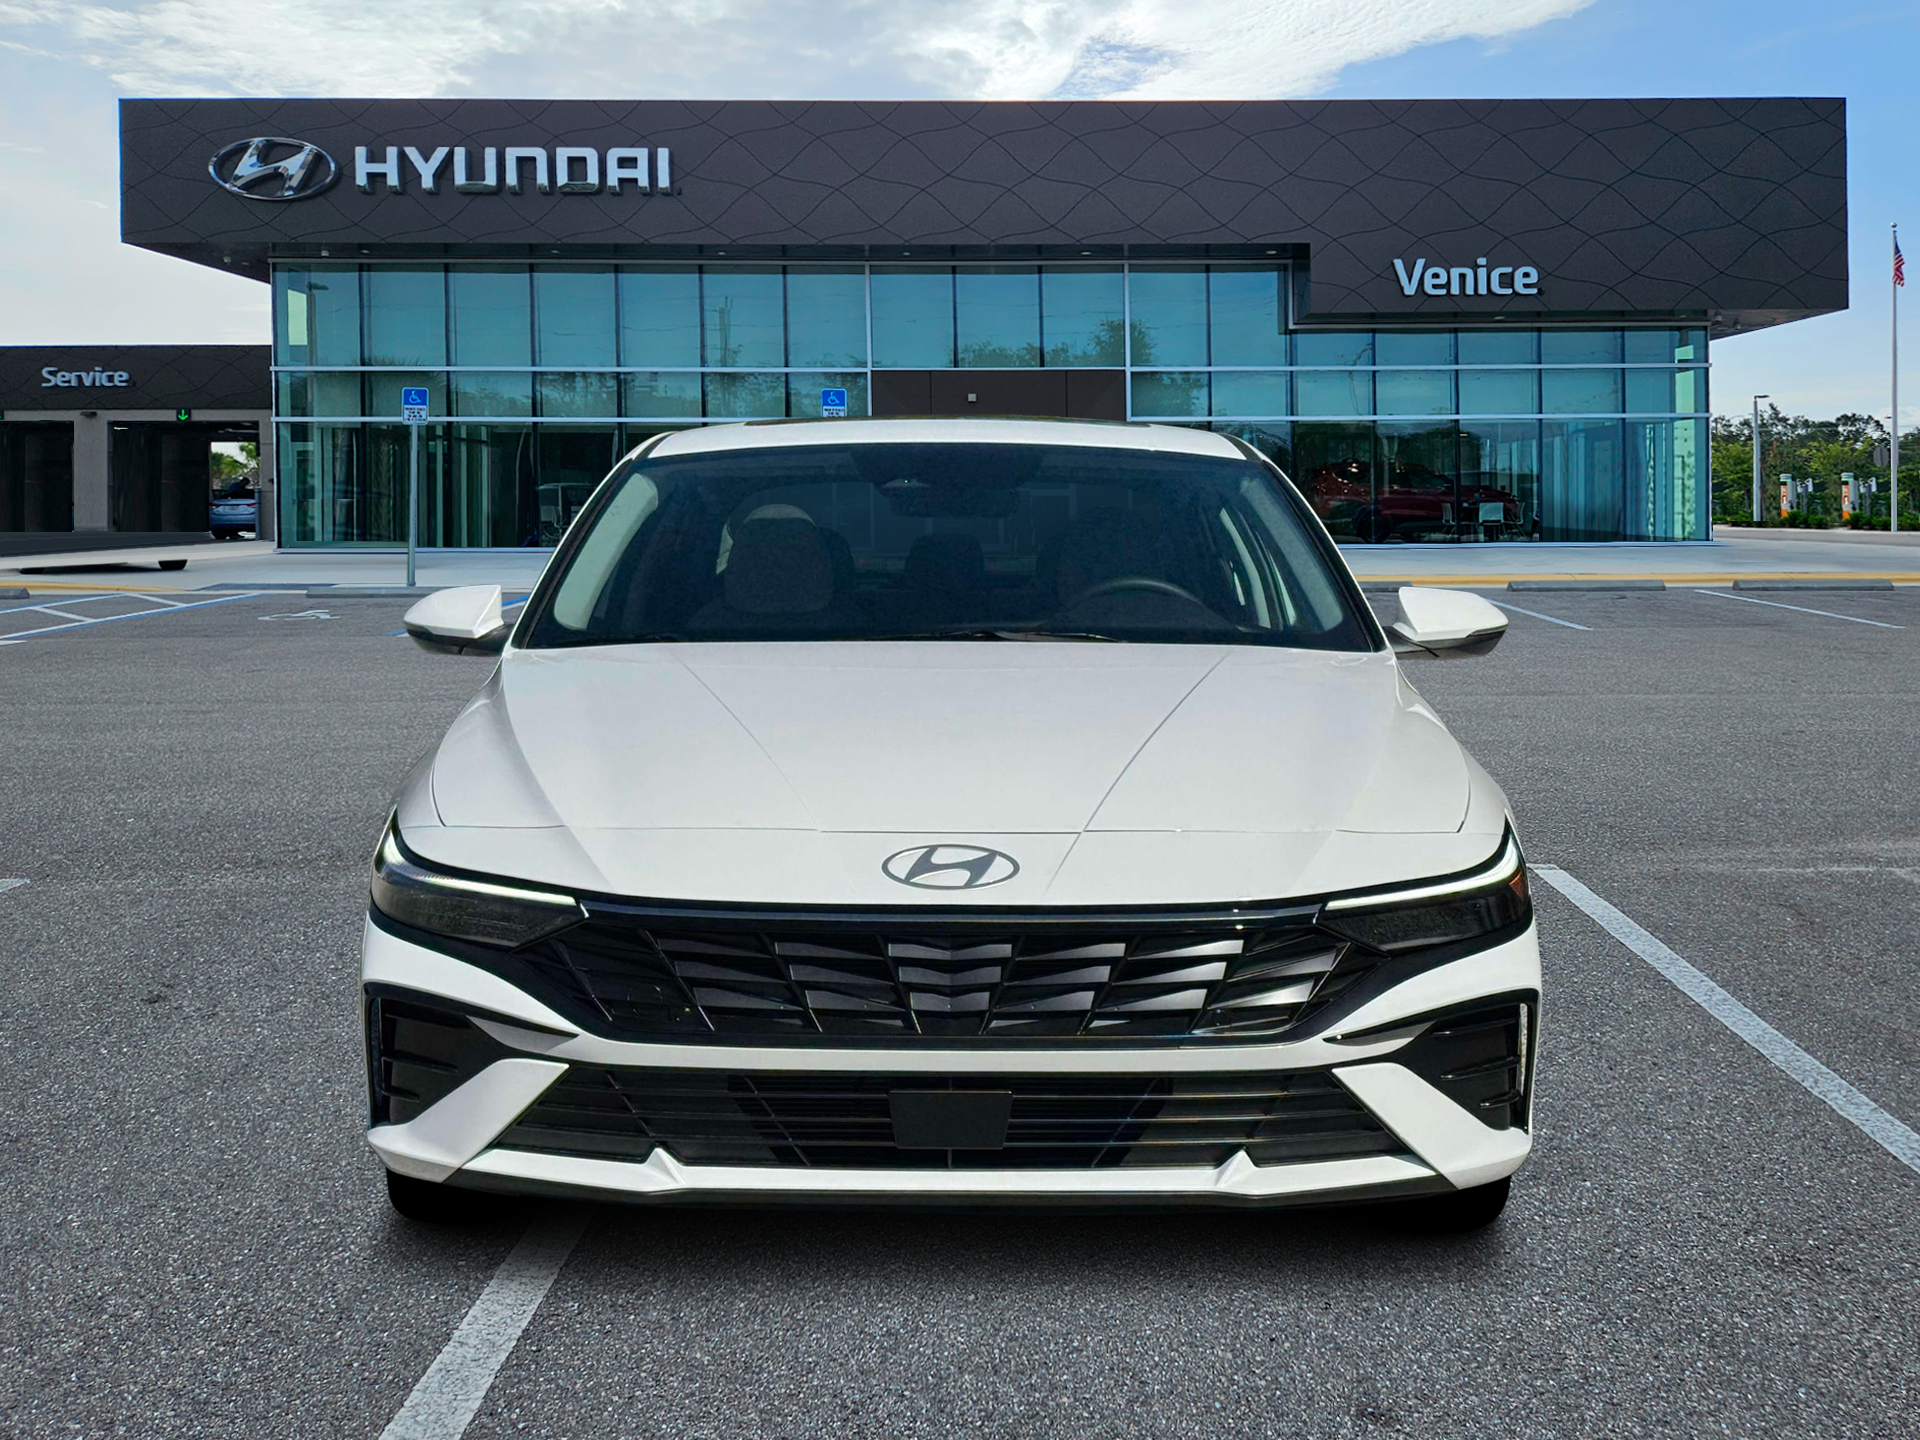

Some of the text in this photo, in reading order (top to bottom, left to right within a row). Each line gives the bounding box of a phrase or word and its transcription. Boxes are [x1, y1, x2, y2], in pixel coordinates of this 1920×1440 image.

[354, 145, 671, 195] HYUNDAI
[1393, 257, 1539, 296] Venice
[41, 366, 130, 388] Service
